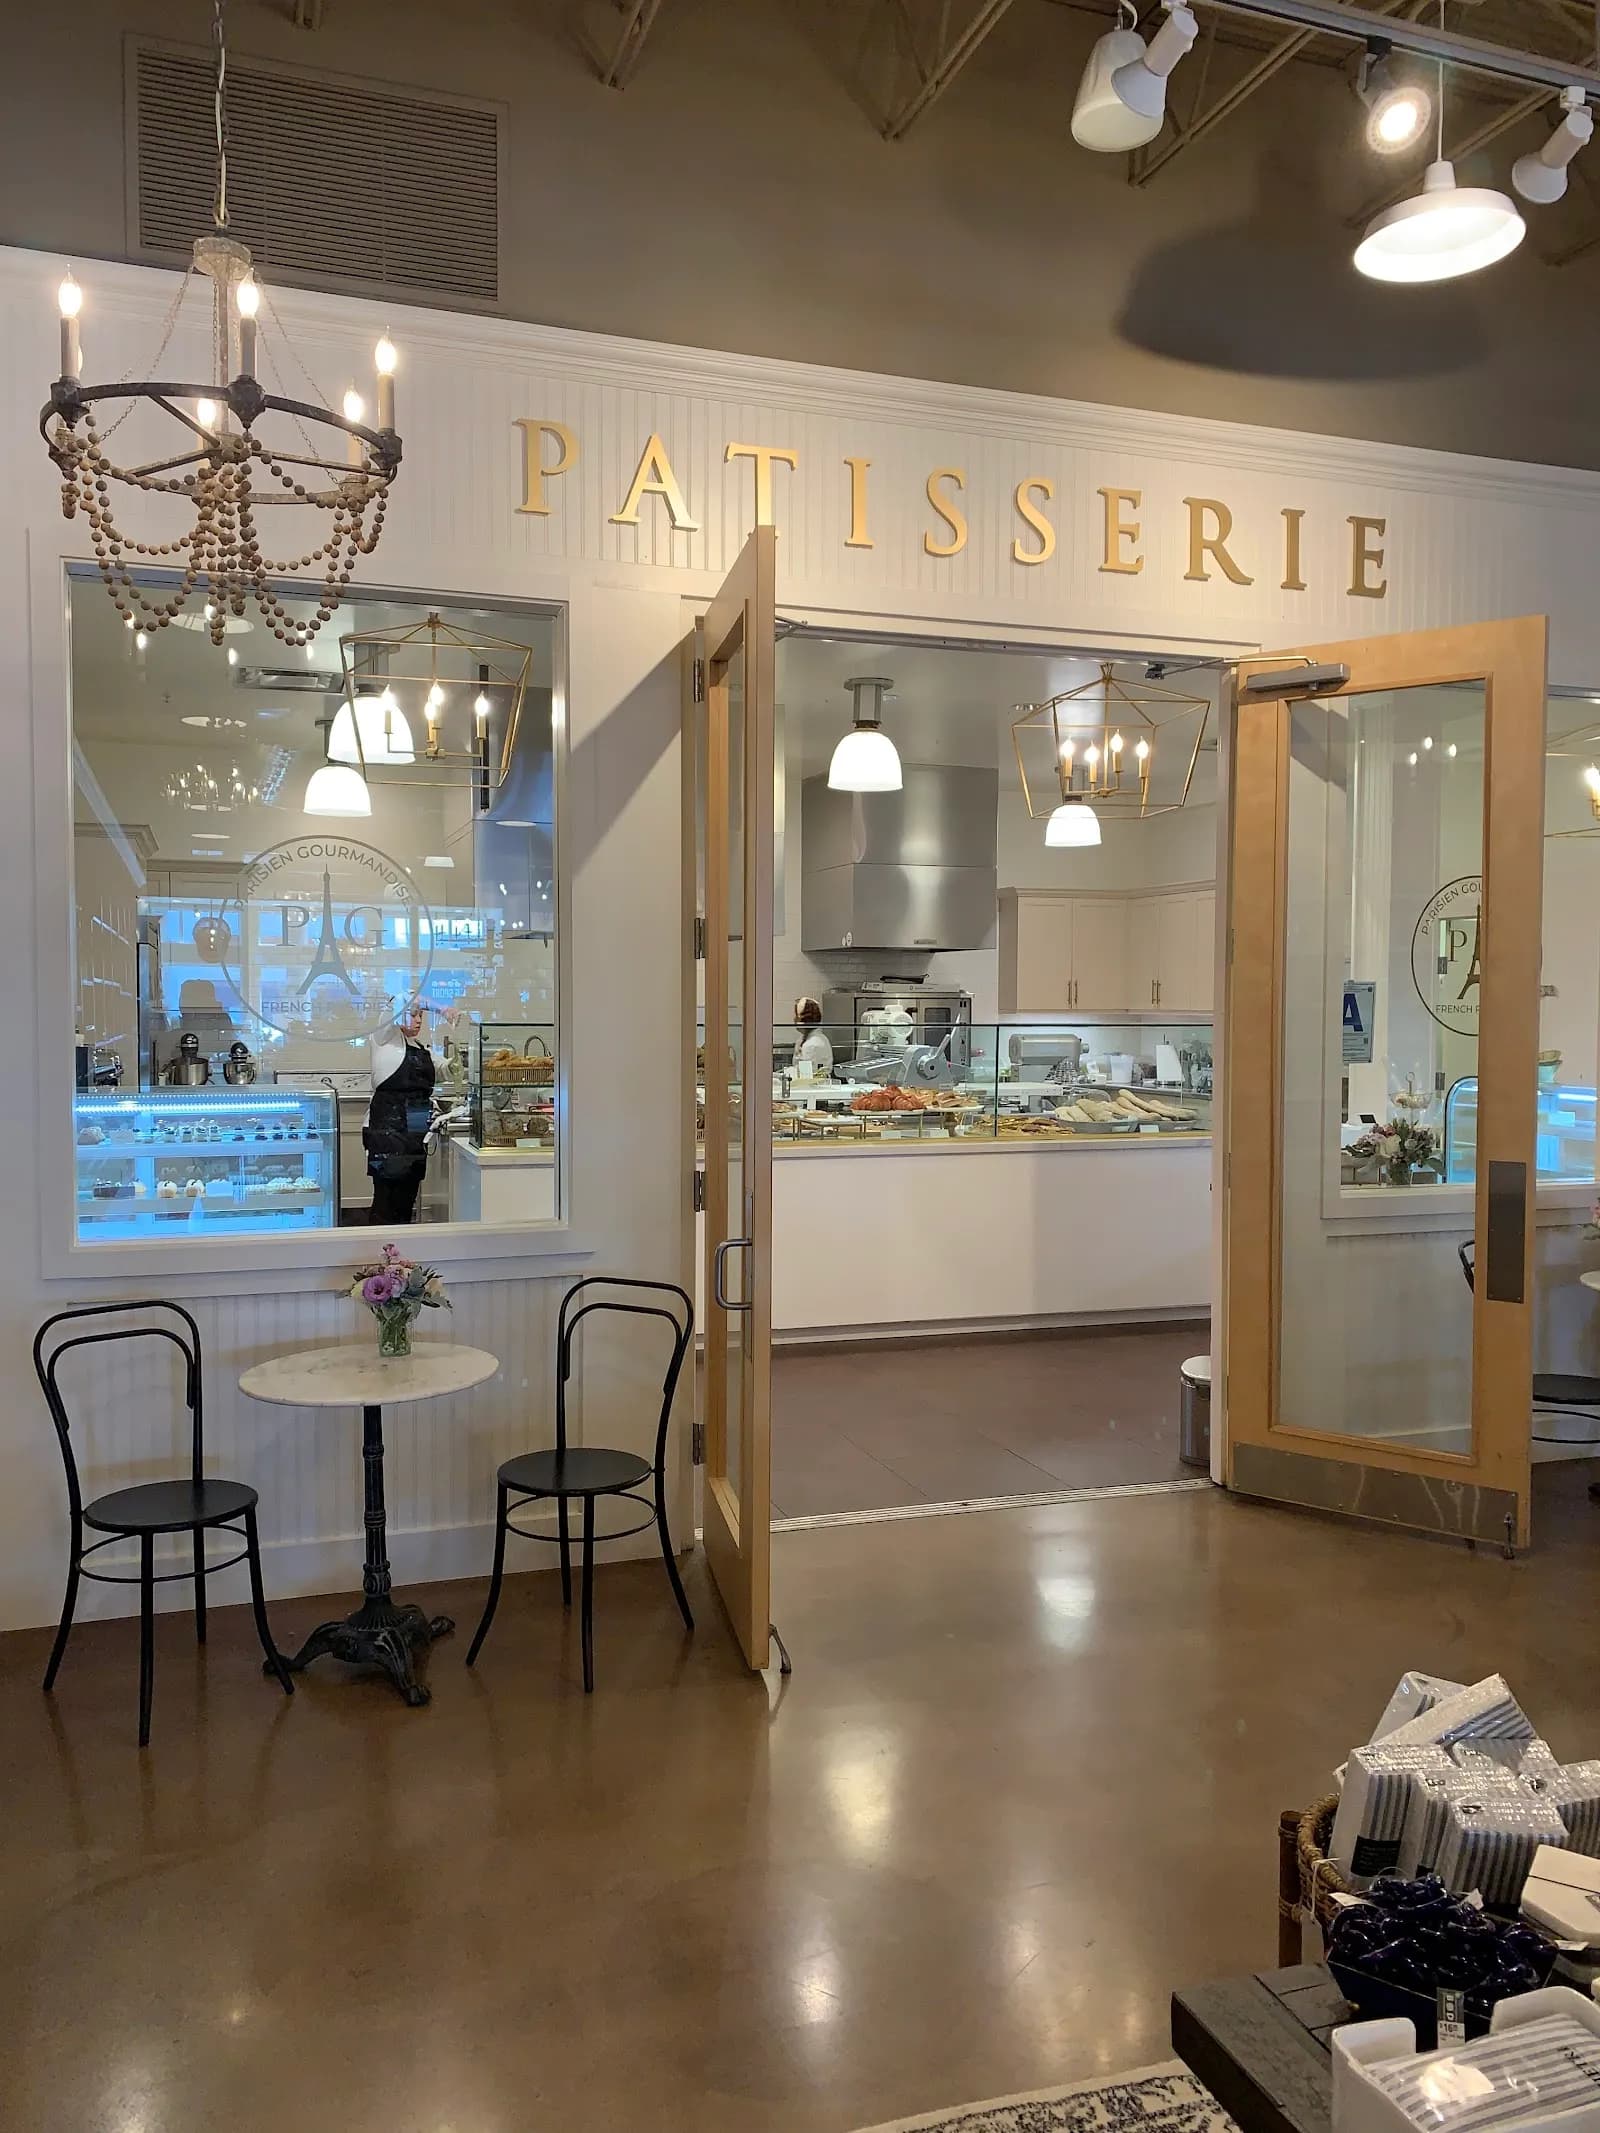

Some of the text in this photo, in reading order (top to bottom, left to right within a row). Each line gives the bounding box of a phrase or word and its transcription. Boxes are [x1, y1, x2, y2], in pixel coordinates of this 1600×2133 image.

[512, 417, 1388, 600] PATISSERIE
[274, 905, 388, 948] P G
[1448, 930, 1467, 962] P
[1435, 1004, 1473, 1014] FRENCH
